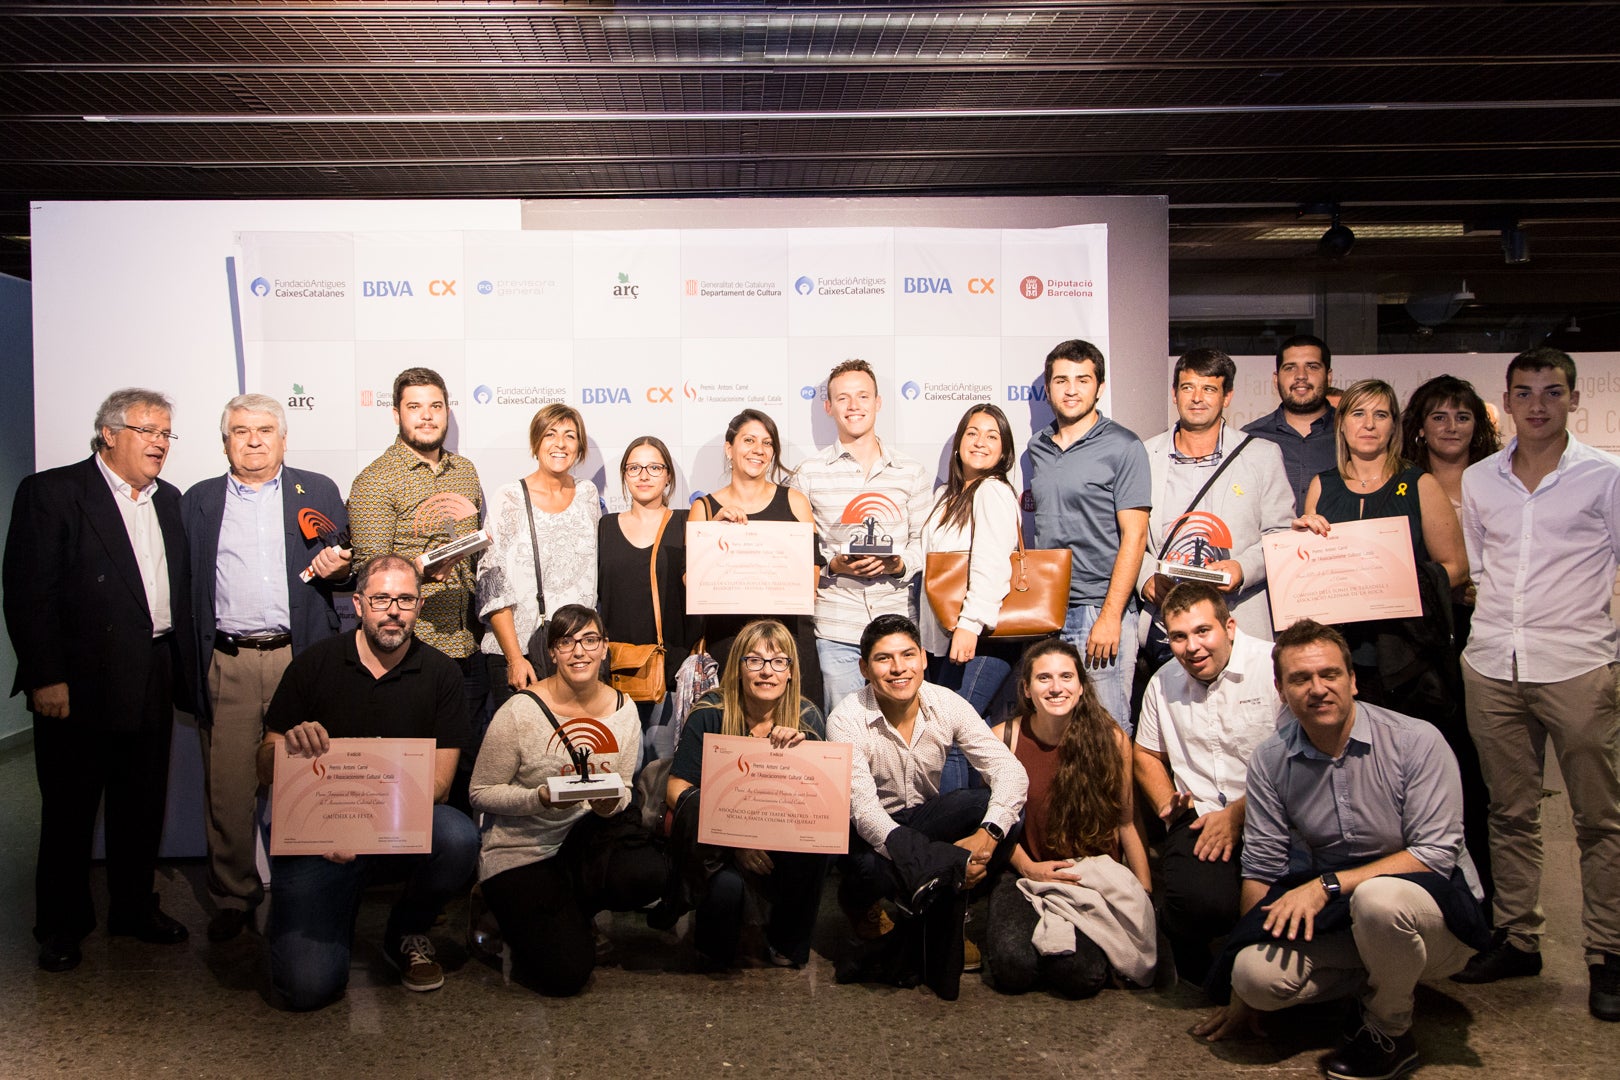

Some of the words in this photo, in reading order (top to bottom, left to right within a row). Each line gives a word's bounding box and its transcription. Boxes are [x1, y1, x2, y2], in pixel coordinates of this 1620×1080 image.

[362, 280, 414, 297] BBVA
[428, 279, 457, 296] CX
[497, 279, 555, 289] previsora
[700, 280, 734, 289] Generalitat
[735, 280, 743, 288] de
[744, 280, 776, 289] Catalunya
[903, 277, 953, 294] BBVA
[967, 277, 995, 294] CX
[1047, 279, 1093, 289] Diputació
[275, 288, 345, 298] CaixesCatalanes
[497, 287, 544, 297] general
[612, 283, 640, 300] arç
[700, 288, 748, 298] Departament
[749, 288, 756, 297] de
[756, 288, 782, 297] Cultura
[818, 286, 886, 296] CaixesCatalanes
[1047, 288, 1093, 297] Barcelona
[924, 382, 993, 393] FundacióAntigues
[582, 387, 632, 404] BBVA
[646, 386, 674, 403] CX
[747, 394, 765, 402] Cultural
[924, 391, 991, 401] CaixesCatalanes
[287, 396, 315, 411] arç
[497, 395, 565, 405] CaixesCatalanes
